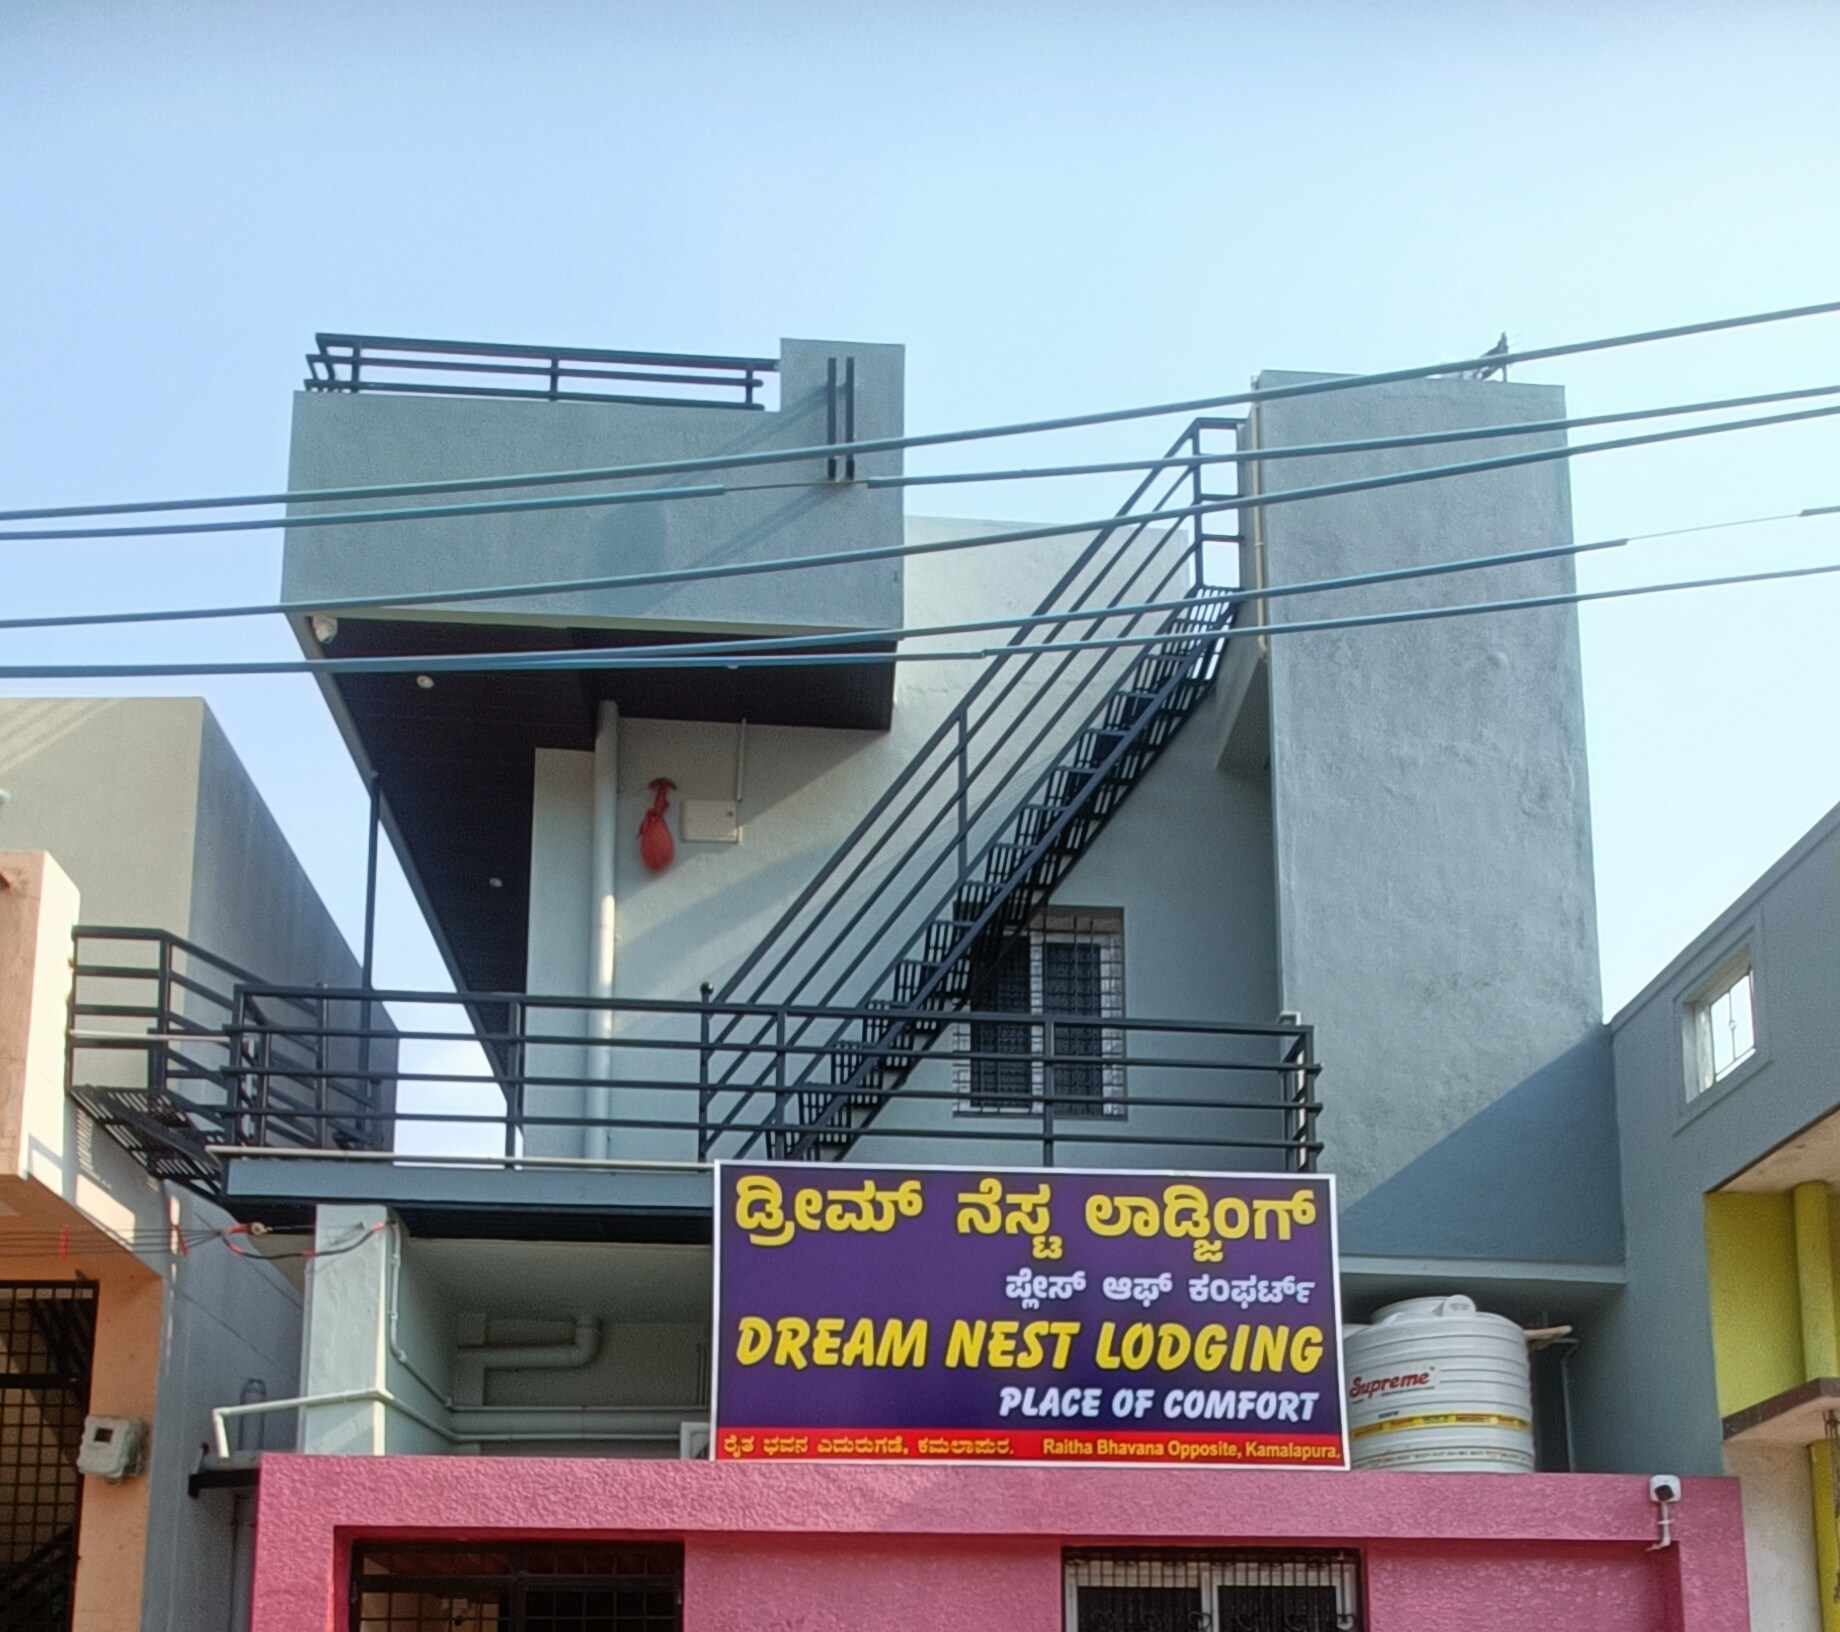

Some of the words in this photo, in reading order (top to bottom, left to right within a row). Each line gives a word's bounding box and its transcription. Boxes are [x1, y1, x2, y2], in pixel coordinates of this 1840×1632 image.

[735, 1175, 923, 1246] ಡ್ರೀಮ್
[1085, 1184, 1316, 1262] ಲಾಡ್ಜಿಂಗ್
[1005, 1267, 1087, 1310] ಪ್ಲೇಸ್
[1102, 1272, 1173, 1307] ಆಫ್
[736, 1316, 928, 1370] DREAM
[945, 1319, 1081, 1369] NEST
[1095, 1321, 1324, 1373] LODGING
[1349, 1371, 1430, 1398] Supreme
[999, 1386, 1103, 1417] PLACE
[1111, 1387, 1155, 1419] OF
[1163, 1389, 1320, 1422] COMFORT
[723, 1434, 754, 1458] ರೈತ
[763, 1436, 809, 1456] ಭವನ
[1043, 1438, 1093, 1455] Raitha
[1096, 1439, 1164, 1456] Bhavana
[1167, 1439, 1242, 1460] Opposite,
[1245, 1441, 1341, 1461] Kamalapura.
